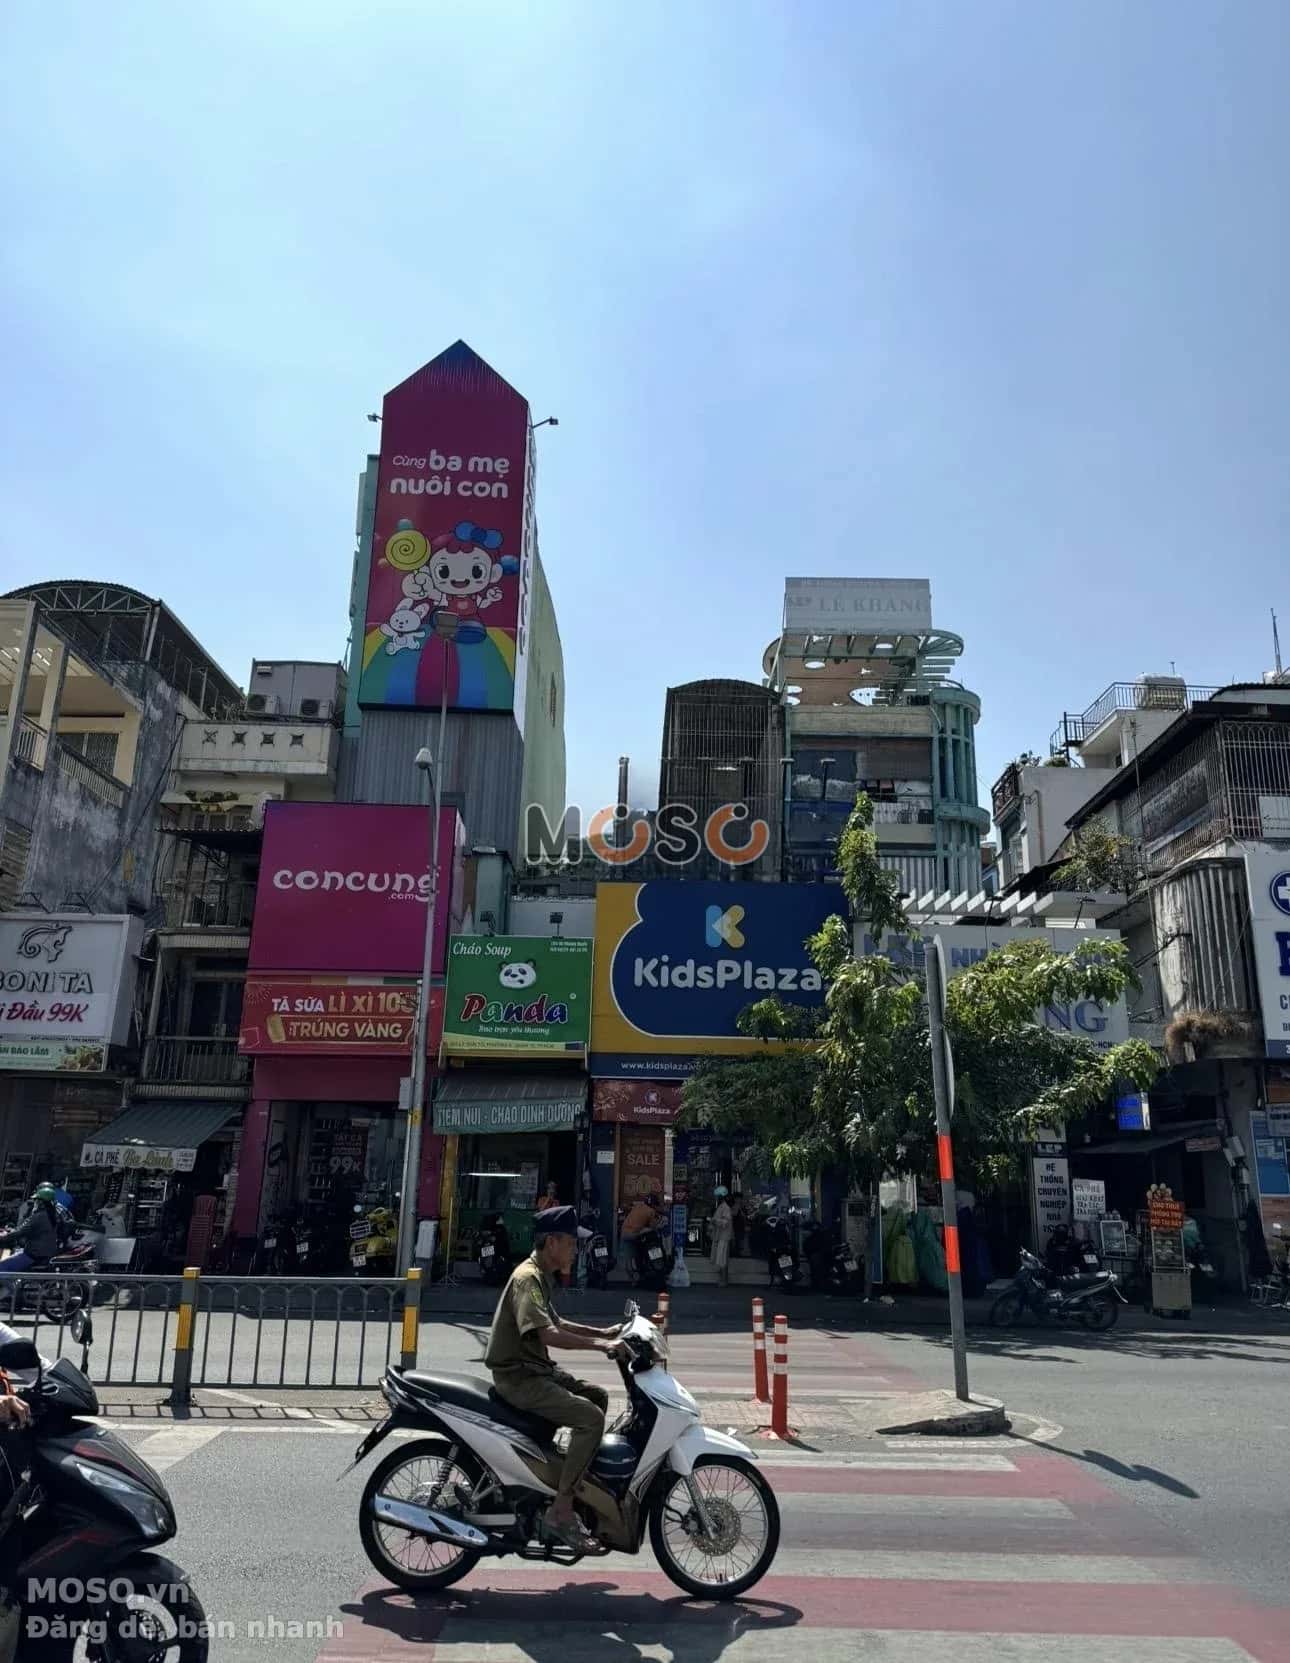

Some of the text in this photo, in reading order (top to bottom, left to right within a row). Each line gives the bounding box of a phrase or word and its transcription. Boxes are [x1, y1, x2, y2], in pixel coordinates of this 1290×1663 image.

[392, 449, 510, 479] Cùng ba mẹ
[390, 475, 508, 499] nuôi con
[453, 942, 512, 957] Cháo Soup
[634, 955, 822, 991] KidsPlaza
[7, 1000, 45, 1020] Đầu
[47, 1002, 89, 1022] 99K
[328, 991, 345, 1013] LÌ
[352, 991, 373, 1013] XÌ
[460, 993, 568, 1024] Panda
[354, 1020, 402, 1039] VÀNG
[626, 1152, 661, 1167] SALE
